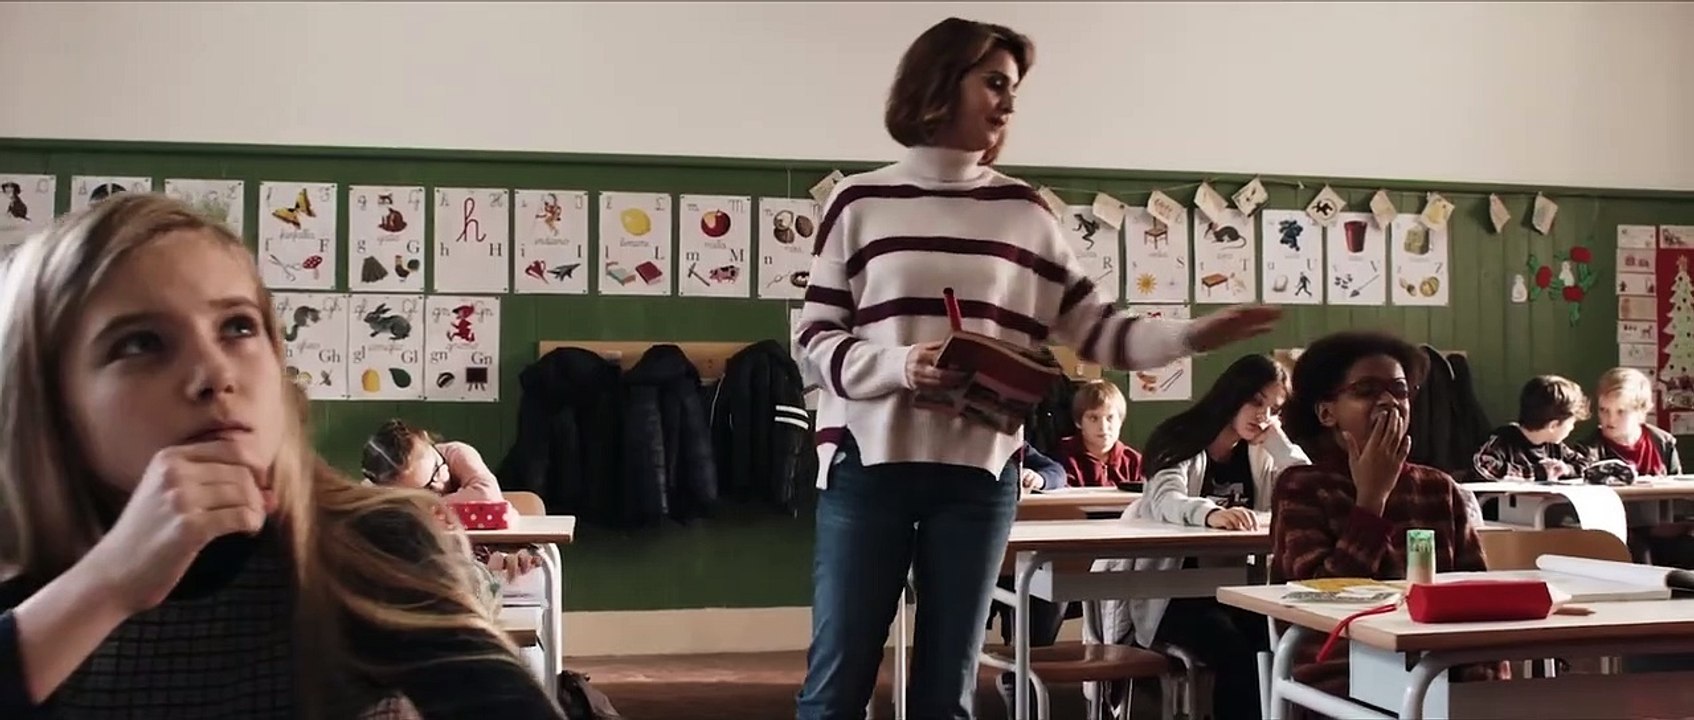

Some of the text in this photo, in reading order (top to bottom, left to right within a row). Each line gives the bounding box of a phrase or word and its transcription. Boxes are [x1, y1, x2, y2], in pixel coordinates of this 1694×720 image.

[456, 197, 487, 243] h
[319, 239, 330, 253] F
[406, 240, 420, 254] G
[440, 242, 502, 257] h H
[521, 243, 582, 258] i I
[654, 246, 665, 260] L
[686, 248, 745, 262] m M
[764, 255, 773, 265] n
[1102, 256, 1113, 269] R
[1175, 256, 1186, 269] S
[1239, 258, 1250, 271] T
[318, 350, 341, 363] Gh
[353, 346, 419, 364] gl Gl
[430, 351, 493, 365] gn Gn
